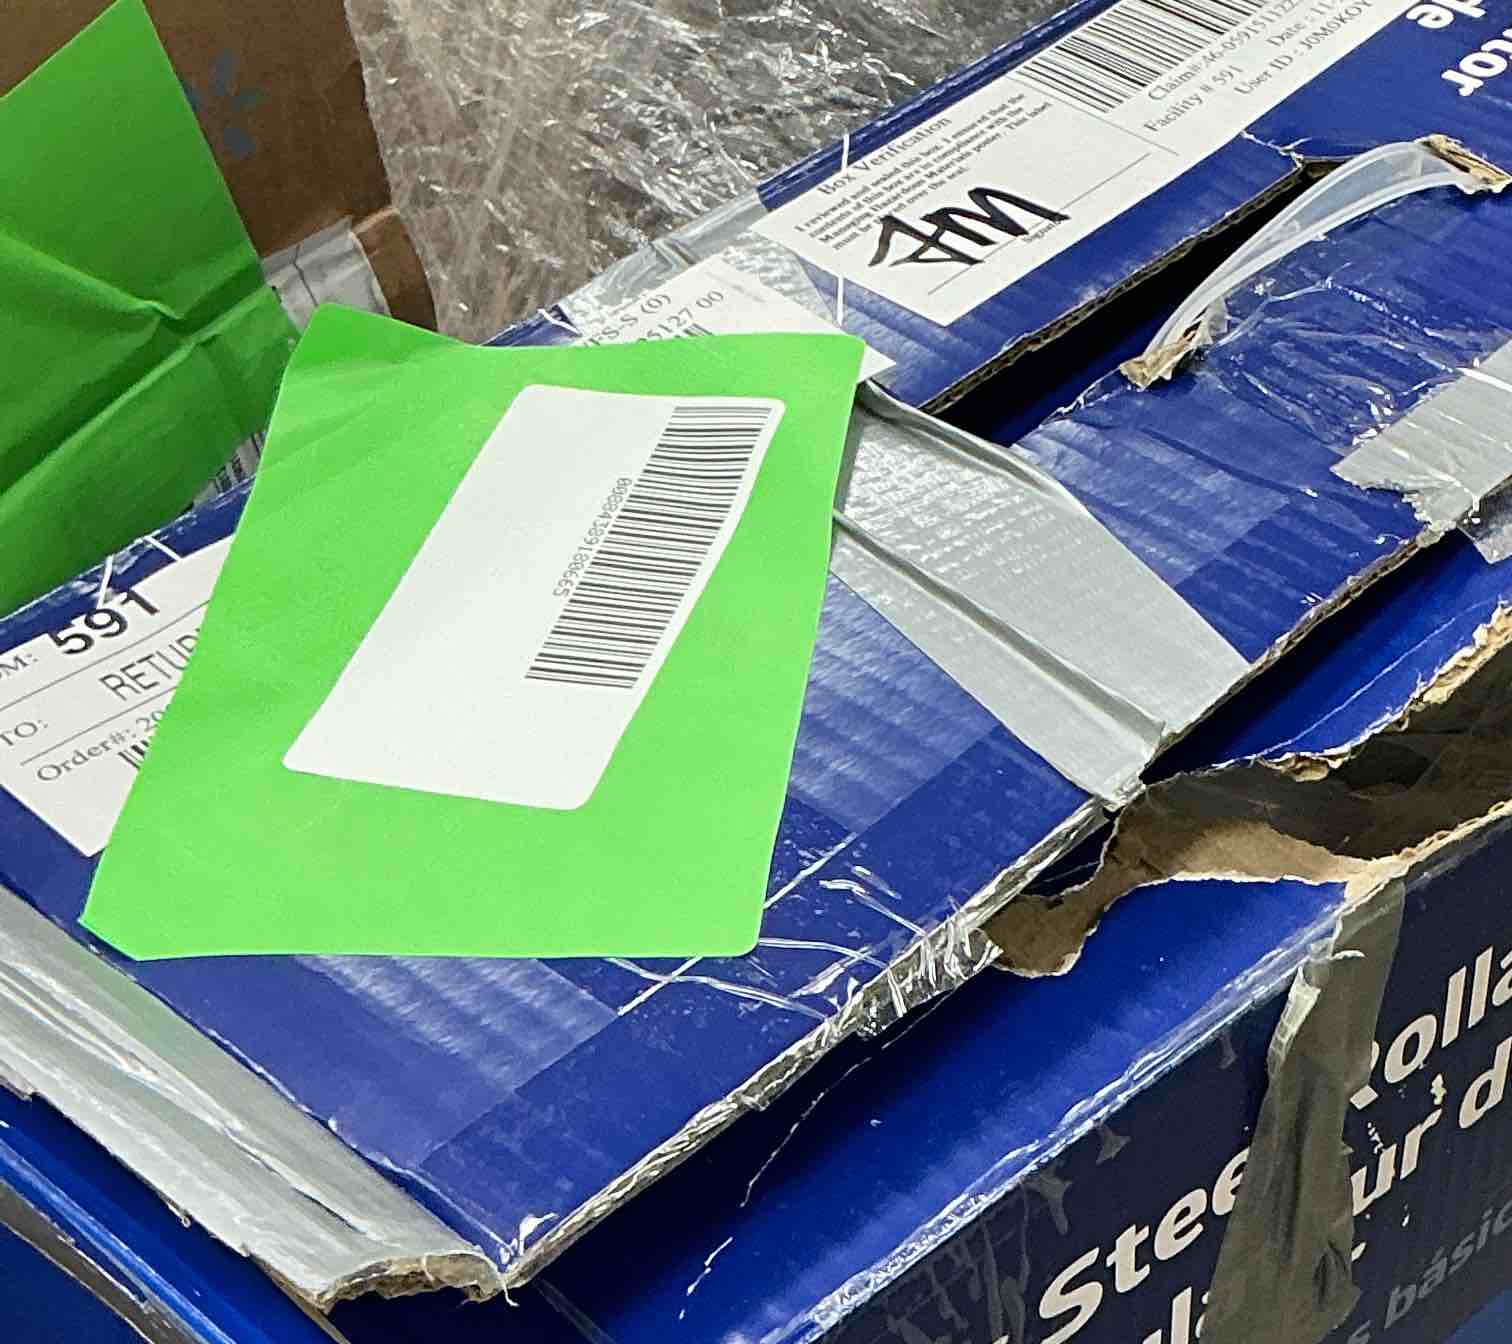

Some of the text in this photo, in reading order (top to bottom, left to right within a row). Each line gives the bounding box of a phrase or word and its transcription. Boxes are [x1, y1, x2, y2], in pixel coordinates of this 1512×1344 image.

[1264, 20, 1309, 47] Date
[1141, 92, 1207, 133] Facility
[1207, 63, 1245, 85] 591
[1230, 68, 1276, 96] User
[1265, 52, 1298, 71] ID
[816, 113, 953, 196] Box Verification
[50, 590, 160, 656] 591
